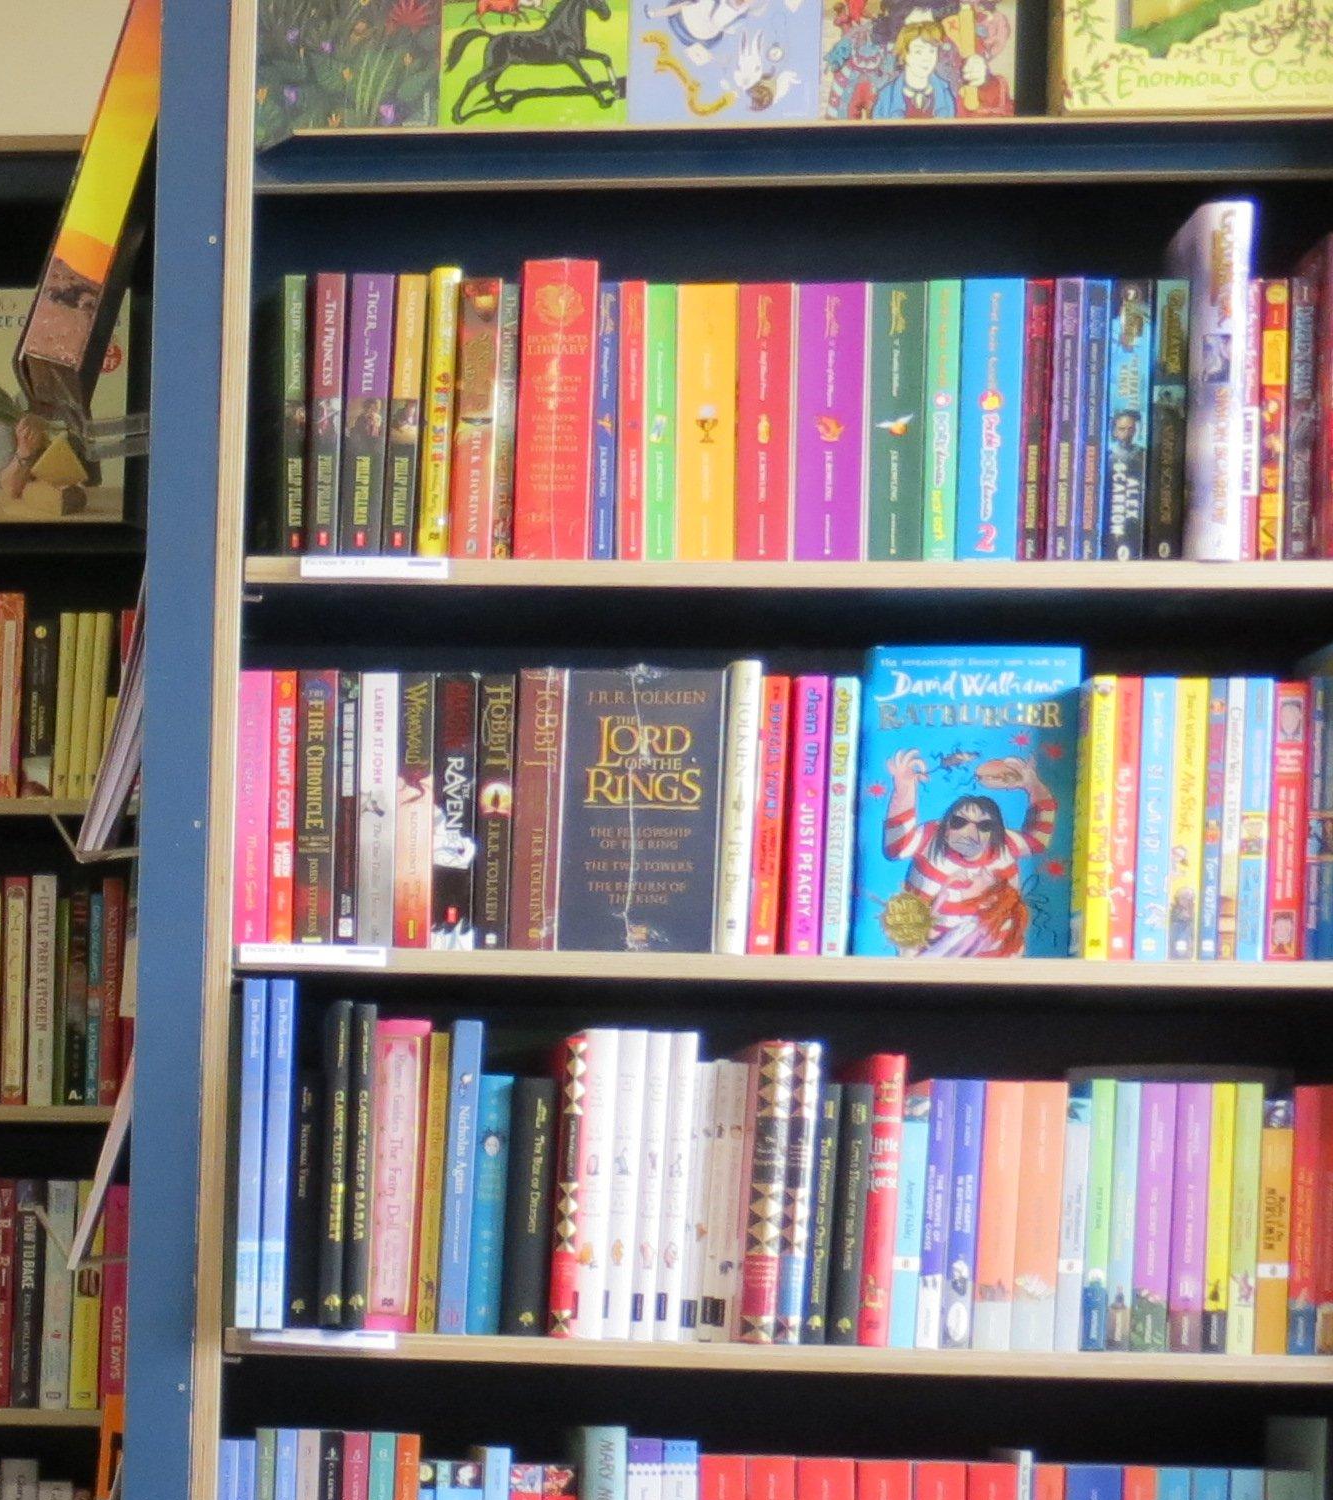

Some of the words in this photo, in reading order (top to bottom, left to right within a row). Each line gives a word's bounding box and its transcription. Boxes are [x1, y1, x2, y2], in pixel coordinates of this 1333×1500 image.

[1115, 65, 1238, 99] Enormous
[363, 290, 379, 336] TIGER
[321, 327, 335, 387] PRINCESS
[361, 356, 377, 393] WELL
[466, 468, 481, 534] RIORDAN
[1111, 461, 1127, 537] SCARROW
[1125, 476, 1140, 519] ALEX
[634, 689, 708, 705] TOLKIEN
[874, 671, 957, 702] David
[958, 670, 1067, 700] Walliams
[276, 706, 292, 744] DEAD
[307, 700, 324, 739] FIRE
[483, 684, 513, 772] HOBBIT
[523, 676, 559, 773] HOBBIT
[804, 688, 819, 735] Jean
[835, 687, 852, 734] Jean
[878, 700, 1064, 730] RATBURGER
[597, 715, 692, 768] LORD
[624, 757, 646, 770] OF
[647, 757, 682, 770] THE
[304, 744, 326, 830] CHRONICLE
[462, 782, 472, 799] THE
[583, 765, 703, 809] RINGS
[275, 790, 291, 830] COVE
[799, 803, 814, 847] JUST
[485, 859, 500, 922] TOLKIEN
[528, 862, 543, 922] TOLKIEN
[796, 853, 814, 919] PEACHY
[33, 977, 50, 1032] KITCHEN
[455, 1105, 471, 1157] Nicholas
[355, 1138, 367, 1174] TALES
[453, 1158, 469, 1195] Again
[384, 1166, 403, 1198] Fairy
[352, 1191, 367, 1240] BABAR
[386, 1204, 402, 1231] Doll
[22, 1243, 34, 1260] TO
[20, 1260, 35, 1290] BAKE
[110, 1305, 123, 1346] CAKE
[109, 1347, 122, 1380] DAYS
[596, 1439, 614, 1480] MARY
